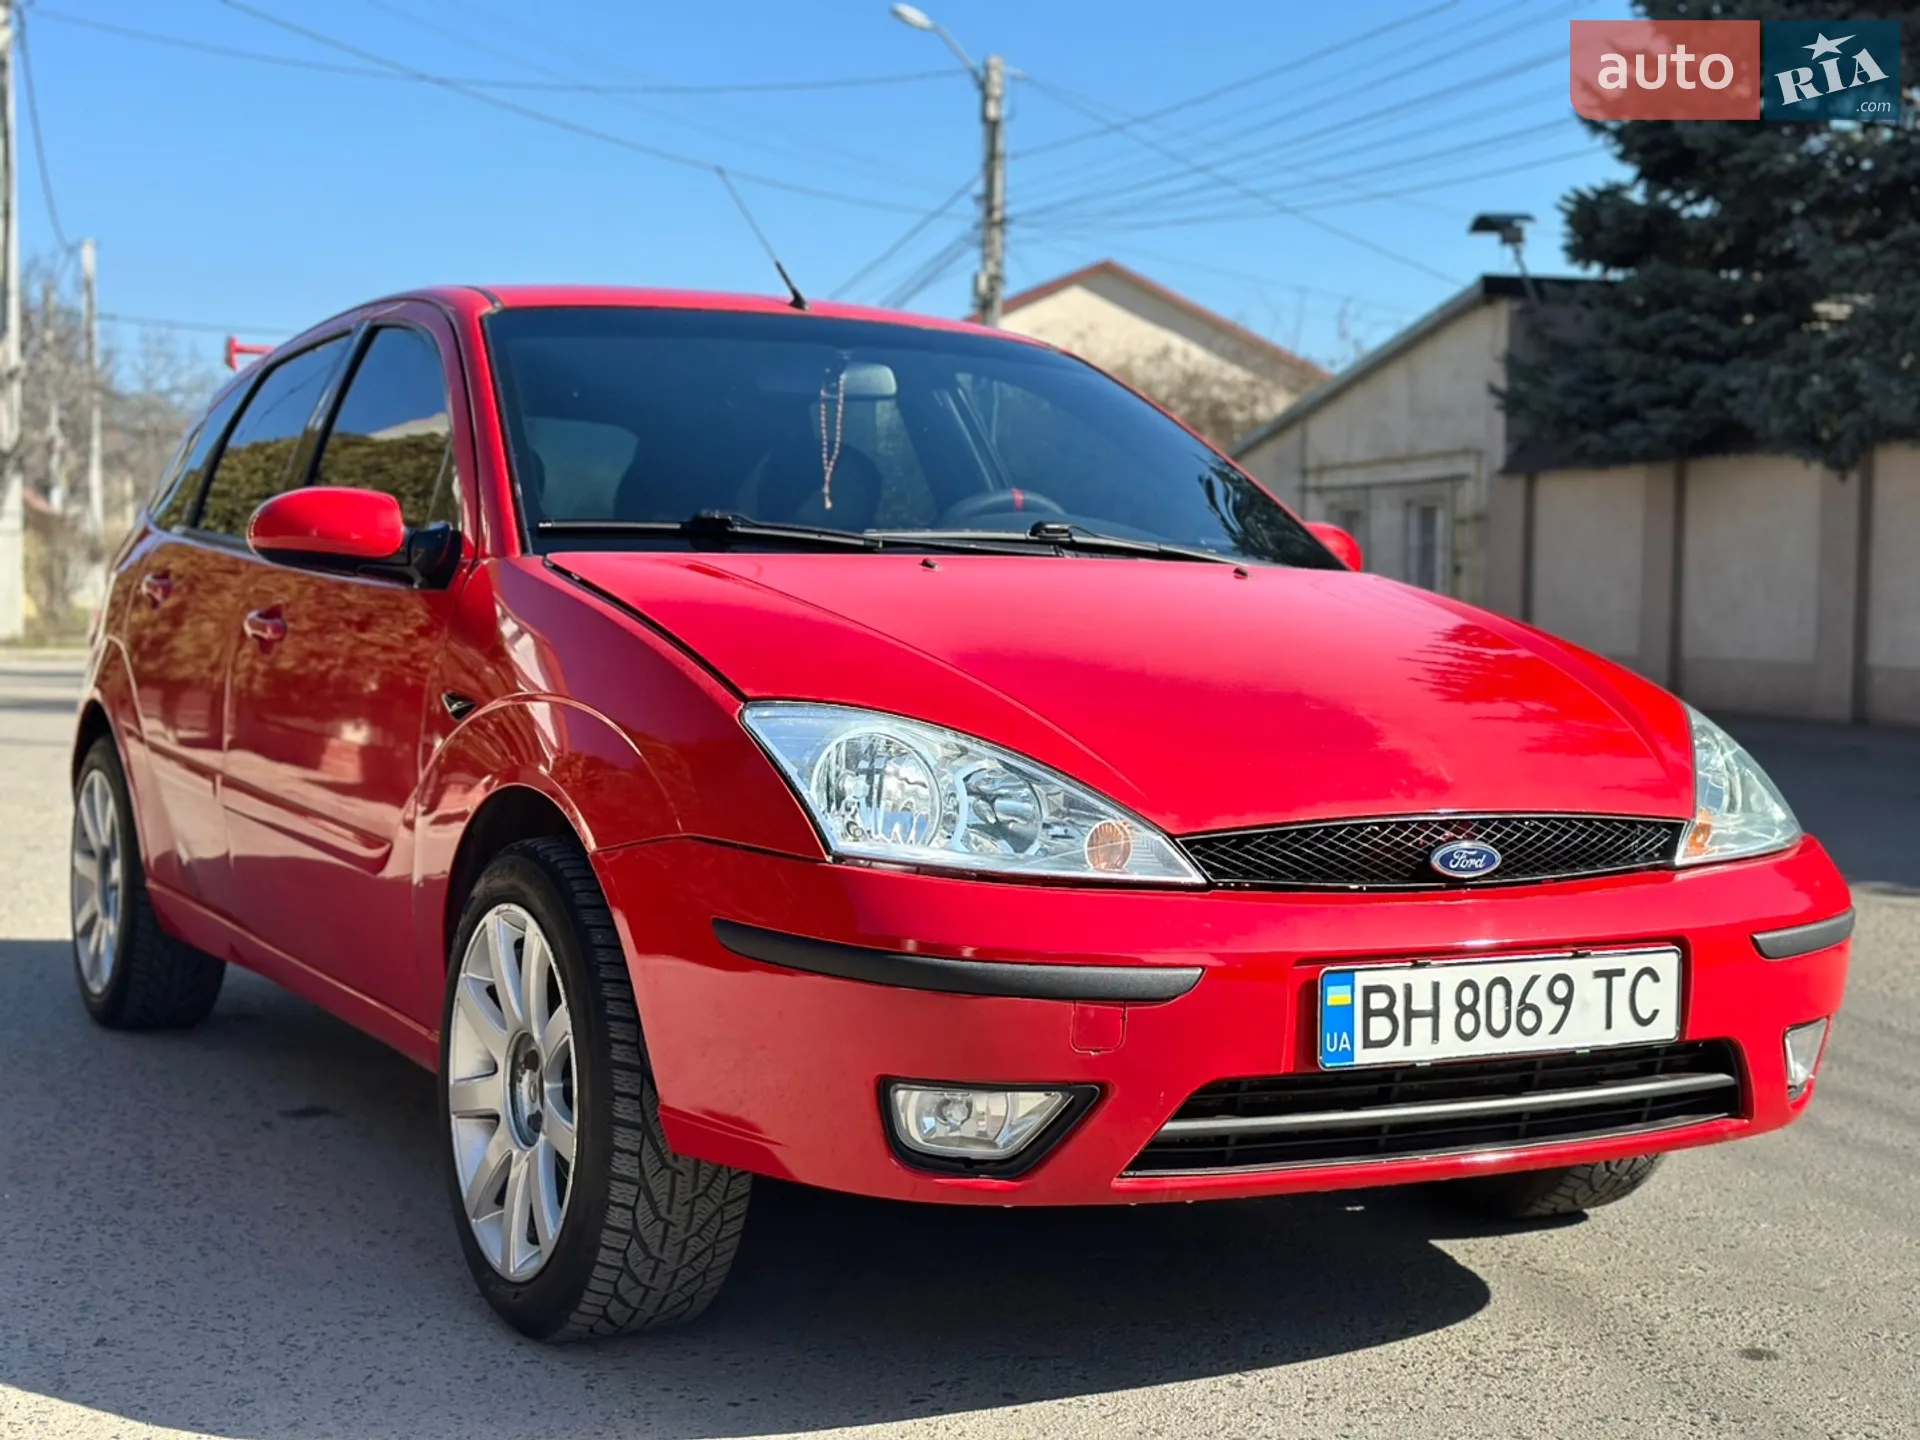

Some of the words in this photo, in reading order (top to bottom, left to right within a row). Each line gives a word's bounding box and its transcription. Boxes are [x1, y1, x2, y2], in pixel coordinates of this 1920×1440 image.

[1449, 849, 1487, 869] Ford
[1361, 980, 1441, 1050] BH
[1454, 972, 1576, 1043] 8069
[1592, 965, 1662, 1031] TC
[1326, 1031, 1351, 1053] UA
